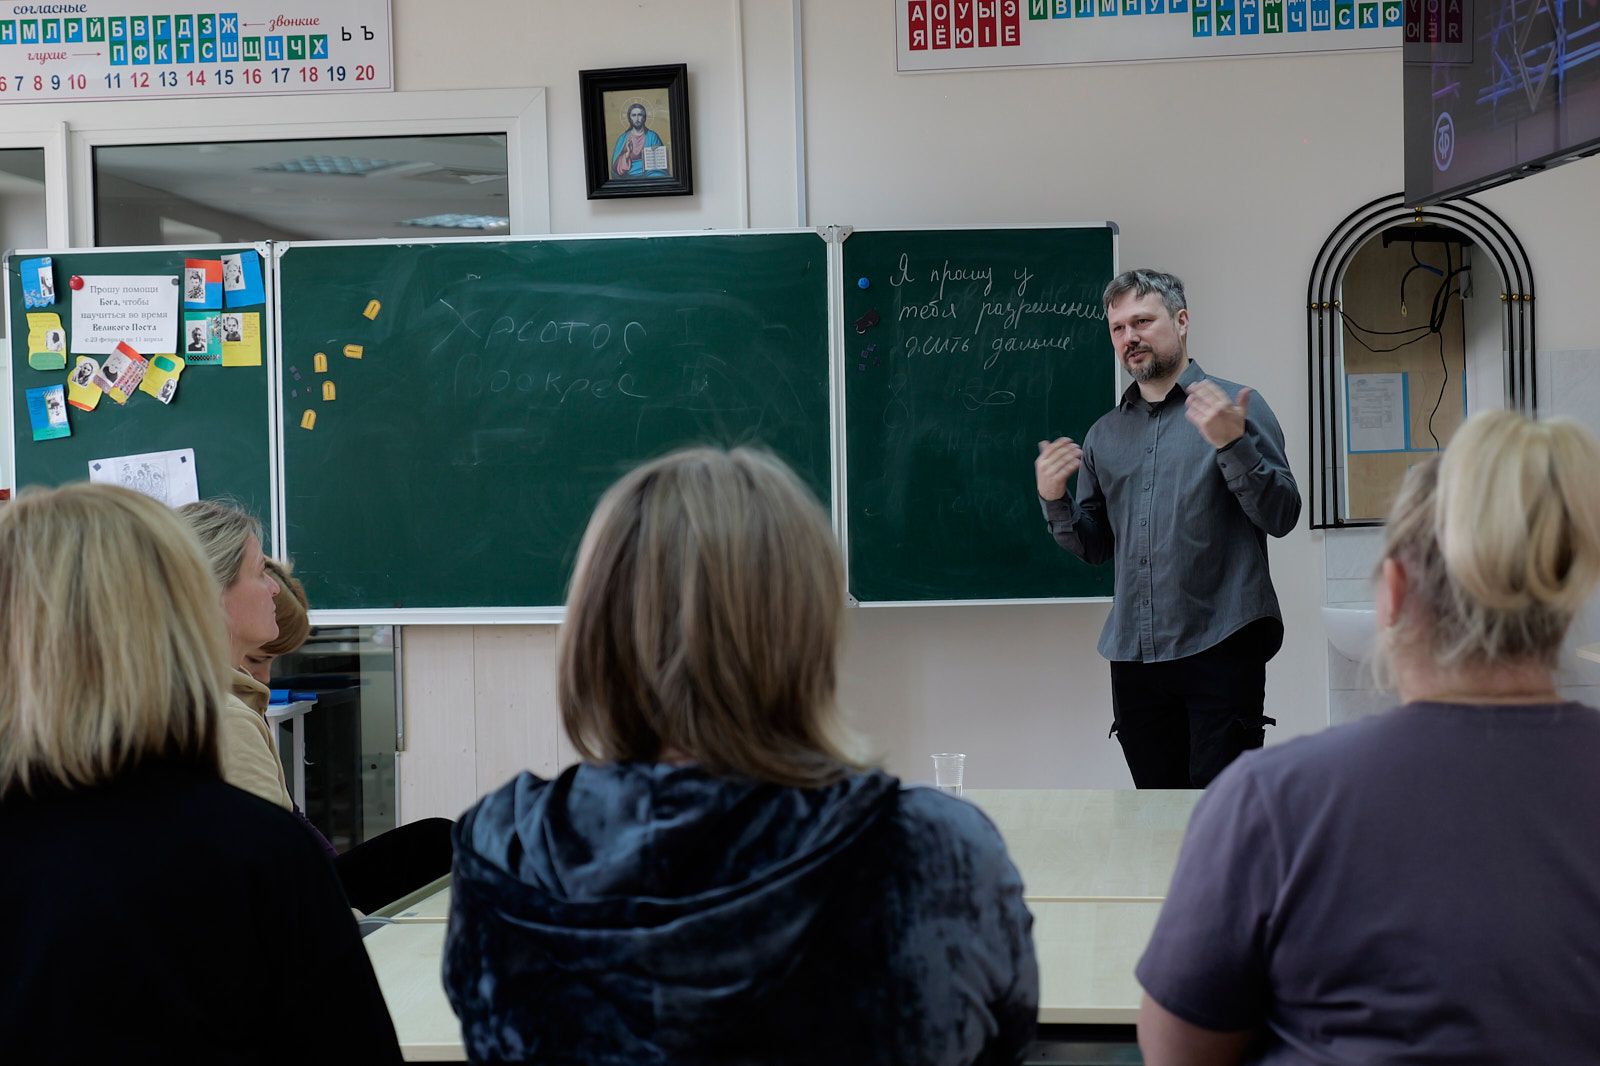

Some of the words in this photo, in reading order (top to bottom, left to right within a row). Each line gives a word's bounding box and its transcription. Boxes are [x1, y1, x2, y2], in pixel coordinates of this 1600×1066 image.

[13, 3, 87, 15] согласные
[911, 5, 924, 21] А
[934, 4, 947, 21] О
[959, 2, 970, 19] У
[979, 1, 995, 18] Ы
[1003, 0, 1016, 17] Э
[2, 24, 13, 40] Н
[23, 24, 36, 39] М
[46, 23, 57, 39] Л
[68, 22, 78, 38] Р
[90, 17, 101, 38] Й
[112, 21, 123, 37] Б
[134, 20, 146, 36] В
[157, 19, 166, 35] Г
[178, 19, 191, 38] Д
[201, 18, 212, 34] З
[221, 17, 236, 34] Ж
[269, 15, 320, 32] звонкие
[1197, 16, 1208, 33] П
[1220, 15, 1232, 31] Х
[1244, 14, 1255, 30] Т
[1267, 13, 1279, 32] Ц
[1291, 11, 1302, 27] Ч
[1313, 10, 1328, 26] Ш
[1339, 9, 1351, 25] С
[1363, 7, 1374, 24] К
[1385, 6, 1400, 22] Ф
[912, 29, 925, 46] Я
[956, 27, 973, 44] Ю
[28, 51, 68, 65] глухие
[113, 46, 124, 61] П
[134, 44, 147, 60] Ф
[157, 44, 167, 60] К
[180, 43, 190, 59] Т
[202, 43, 213, 59] С
[222, 42, 237, 58] Ш
[244, 41, 260, 59] Щ
[268, 40, 280, 59] Ц
[291, 40, 302, 55] Ч
[313, 39, 324, 54] Х
[14, 76, 24, 91] 7
[33, 75, 43, 91] 8
[51, 75, 60, 90] 9
[68, 74, 87, 90] 10
[105, 73, 121, 89] 11
[130, 72, 150, 88] 12
[159, 71, 178, 87] 13
[187, 70, 206, 86] 14
[215, 69, 234, 85] 15
[243, 68, 262, 84] 16
[271, 67, 290, 83] 17
[299, 66, 318, 82] 18
[327, 66, 346, 82] 19
[355, 65, 375, 81] 20
[890, 253, 915, 287] Я
[931, 260, 993, 300] прошу
[1014, 269, 1034, 296] у
[90, 285, 120, 295] Прошу
[122, 286, 159, 294] помощи
[99, 298, 121, 306] Бога,
[122, 298, 149, 306] чтобы
[899, 300, 957, 321] тебя
[80, 312, 126, 320] научиться
[141, 312, 168, 320] время
[92, 323, 130, 331] Великого
[132, 323, 157, 331] Поста
